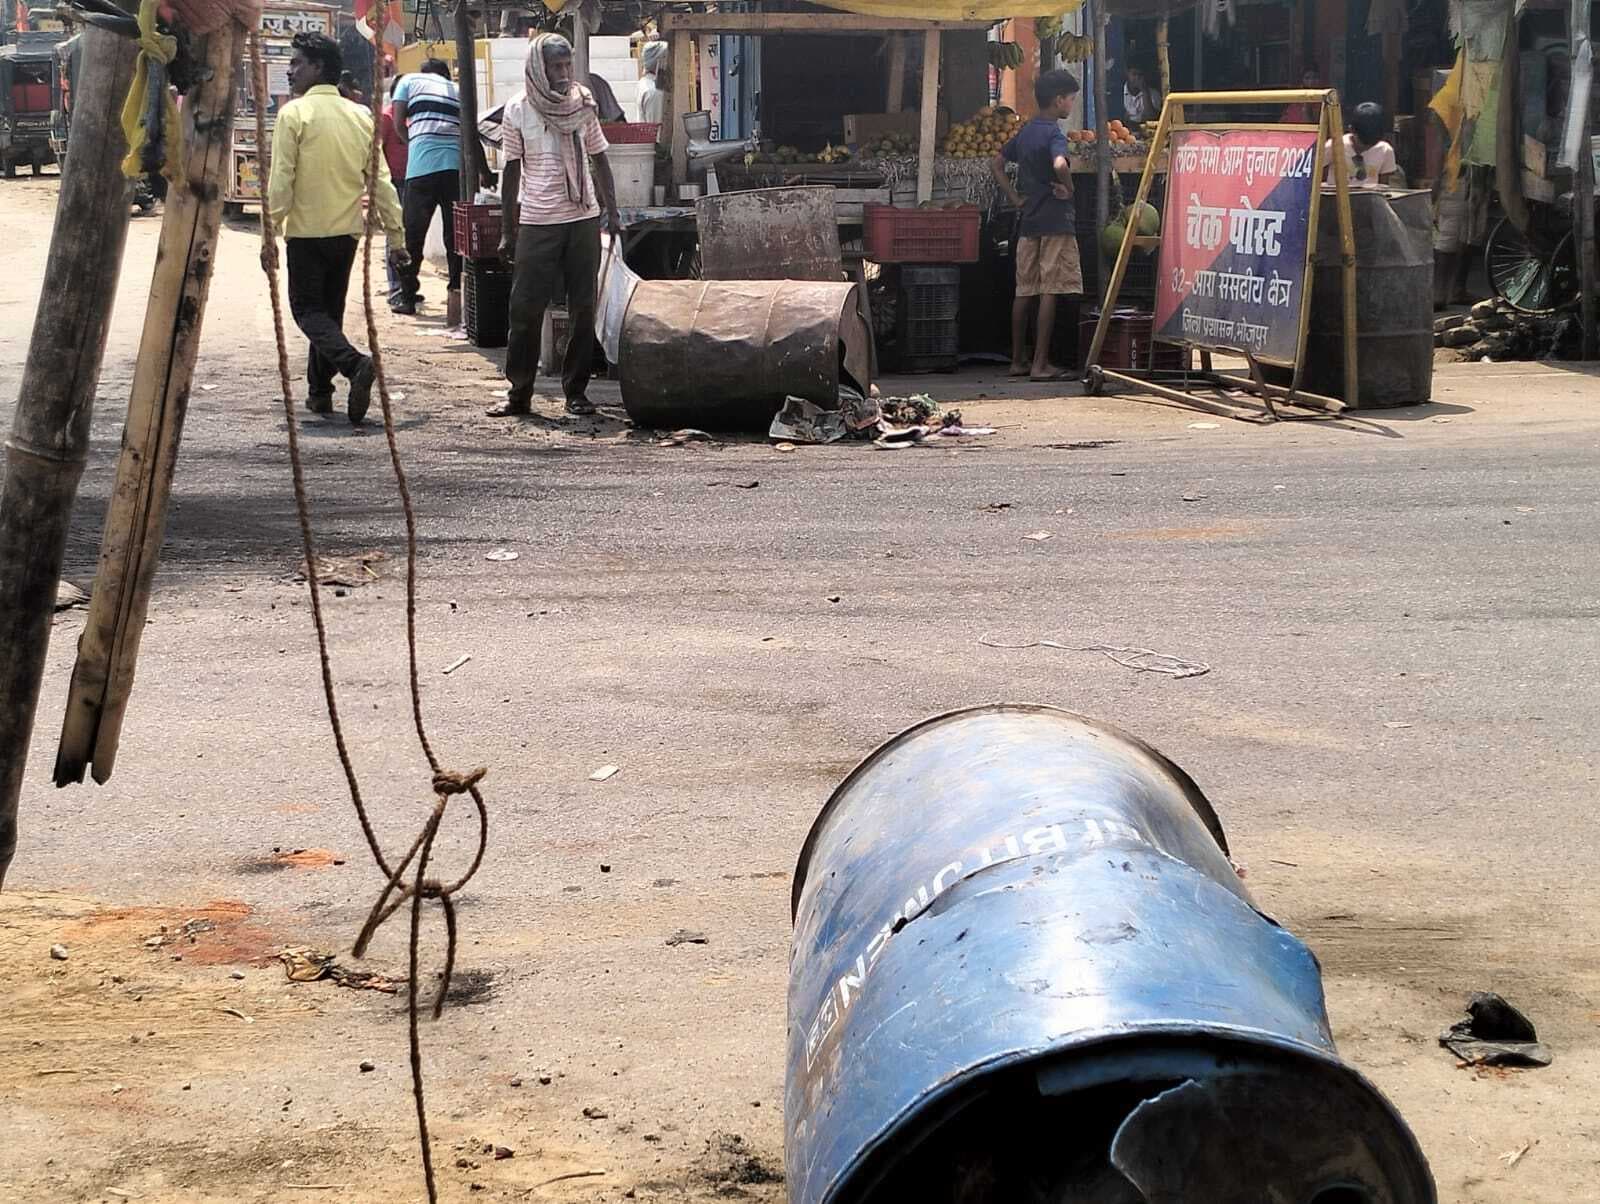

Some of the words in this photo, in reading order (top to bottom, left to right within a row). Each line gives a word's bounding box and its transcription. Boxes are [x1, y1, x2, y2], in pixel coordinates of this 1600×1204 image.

[1221, 146, 1245, 176] आम
[1246, 146, 1280, 186] चुनाव
[1280, 147, 1313, 178] 2024
[1186, 193, 1226, 250] चेक
[1228, 195, 1286, 257] पोस्ट
[1218, 266, 1265, 304] संसदीय
[1268, 270, 1293, 307] क्षेत्र
[1182, 308, 1203, 334] जिला
